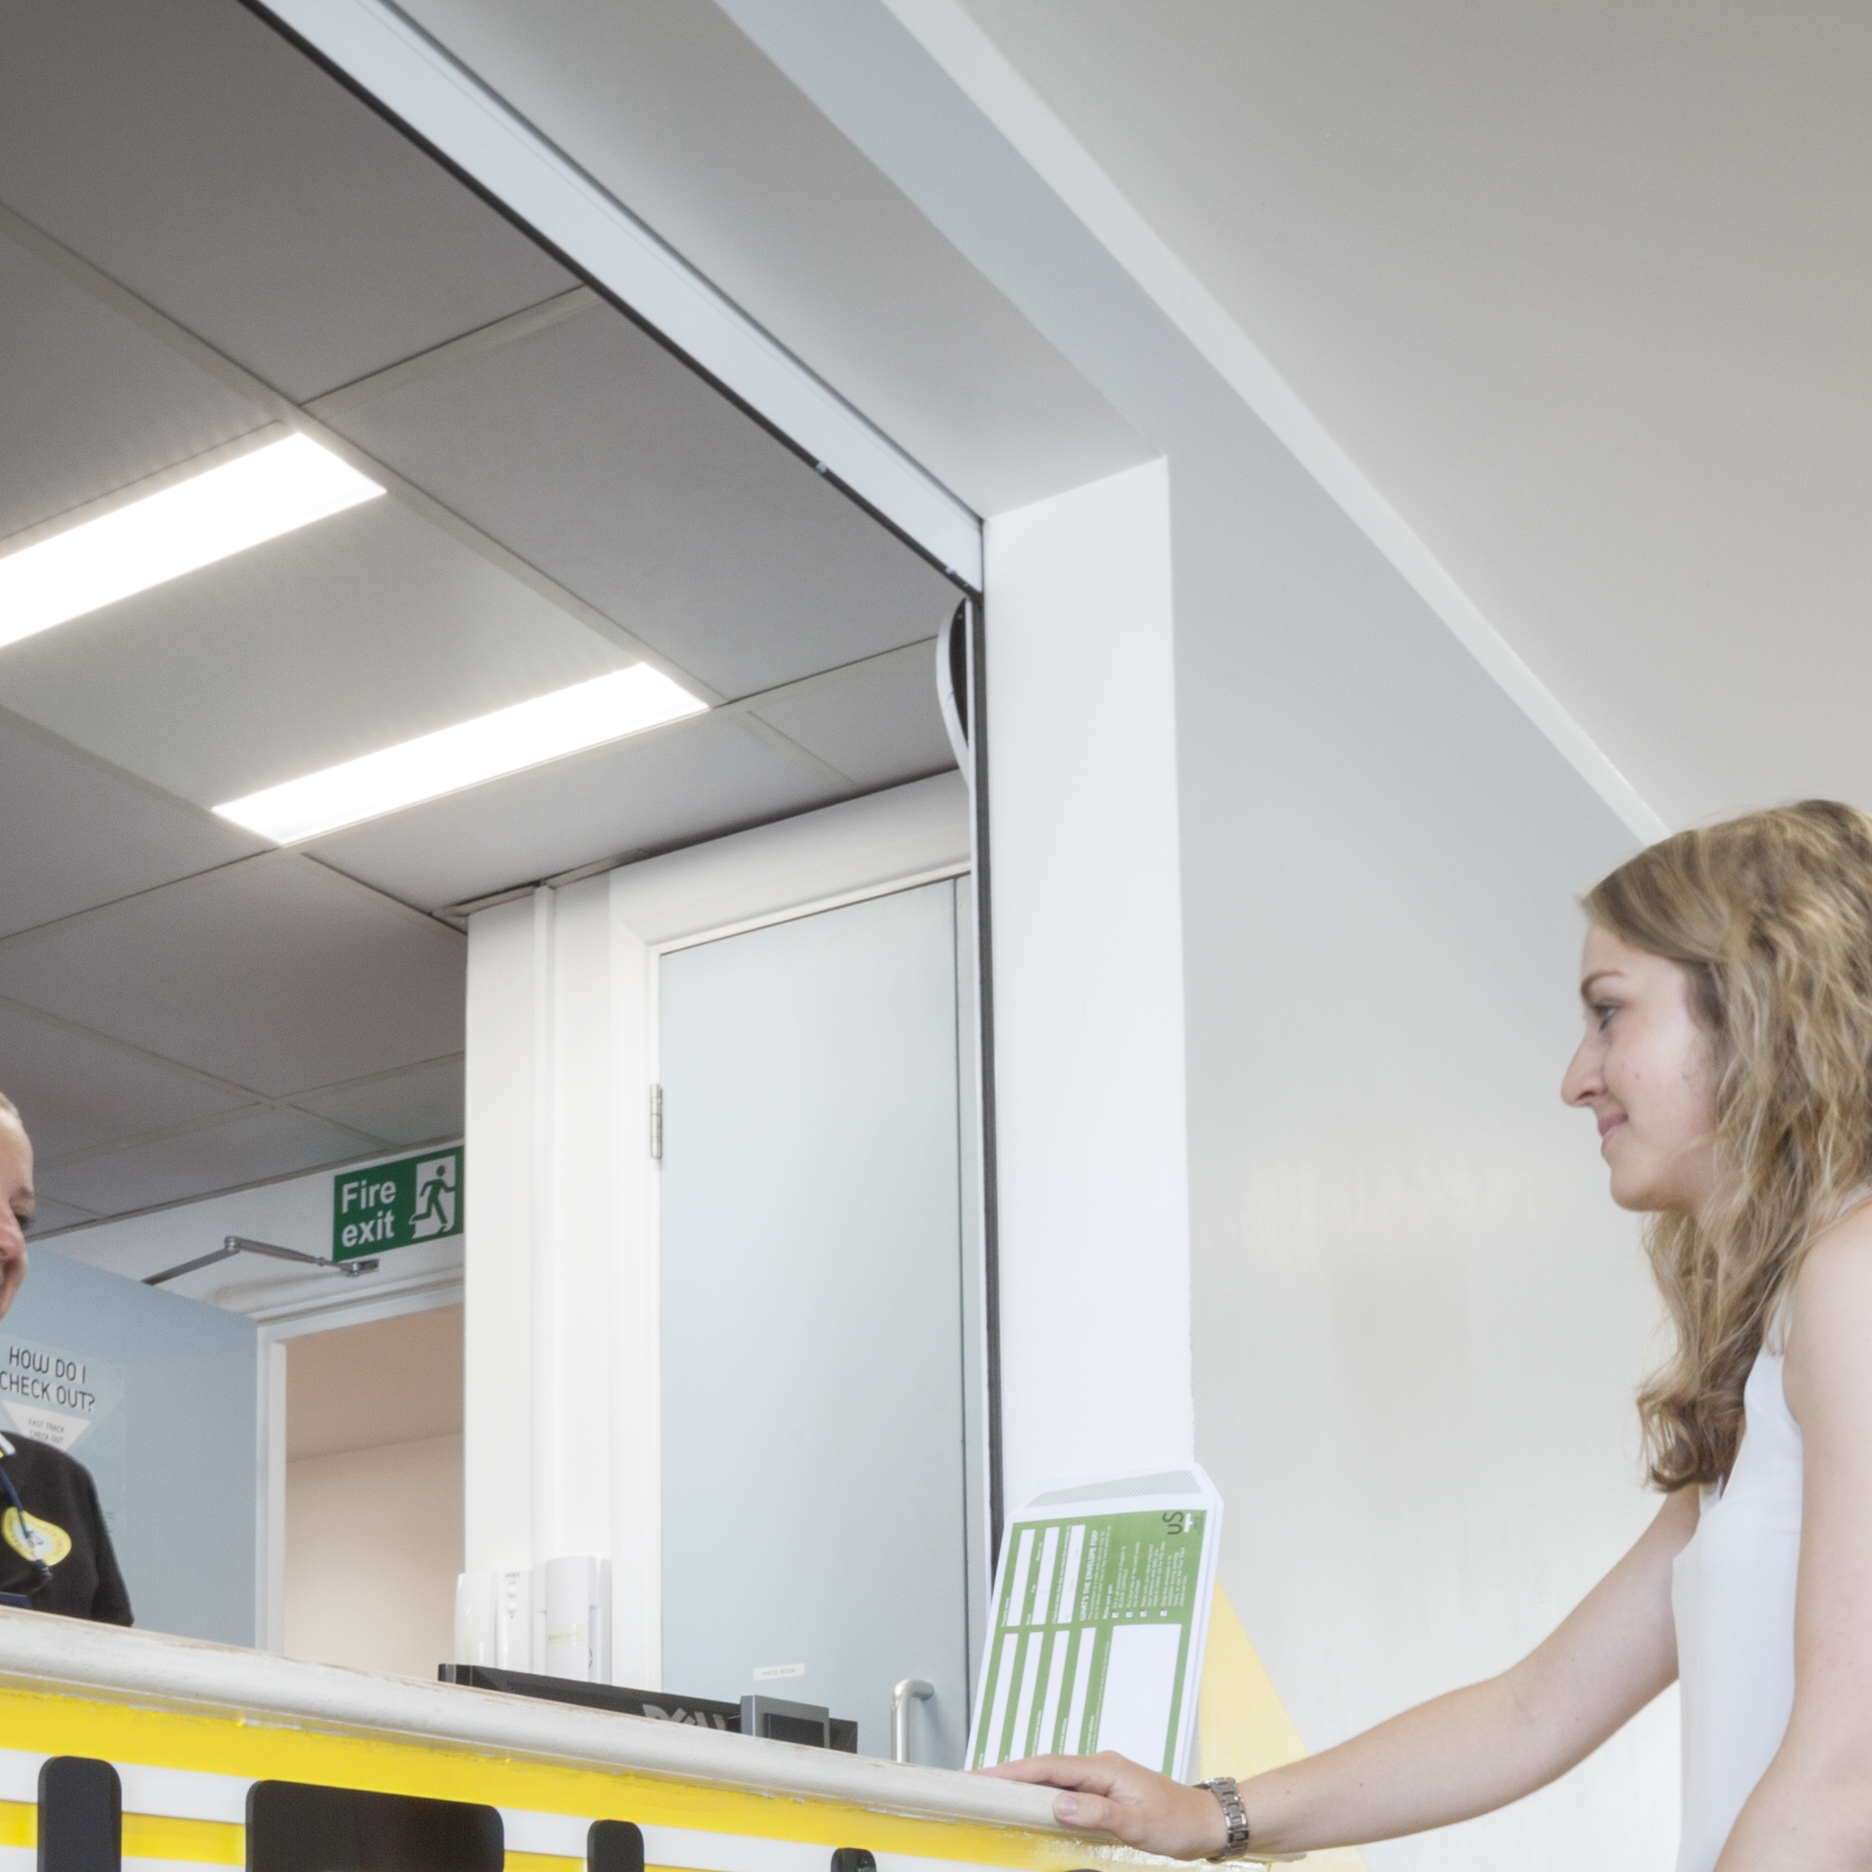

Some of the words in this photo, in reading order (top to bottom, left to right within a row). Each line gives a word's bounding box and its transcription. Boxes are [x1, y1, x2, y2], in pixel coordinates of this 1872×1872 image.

[341, 1179, 397, 1214] Fire
[341, 1208, 395, 1248] exit
[8, 1345, 50, 1375] HOW
[54, 1358, 77, 1382] DO
[81, 1365, 86, 1385] I
[56, 1385, 95, 1413] OUT?
